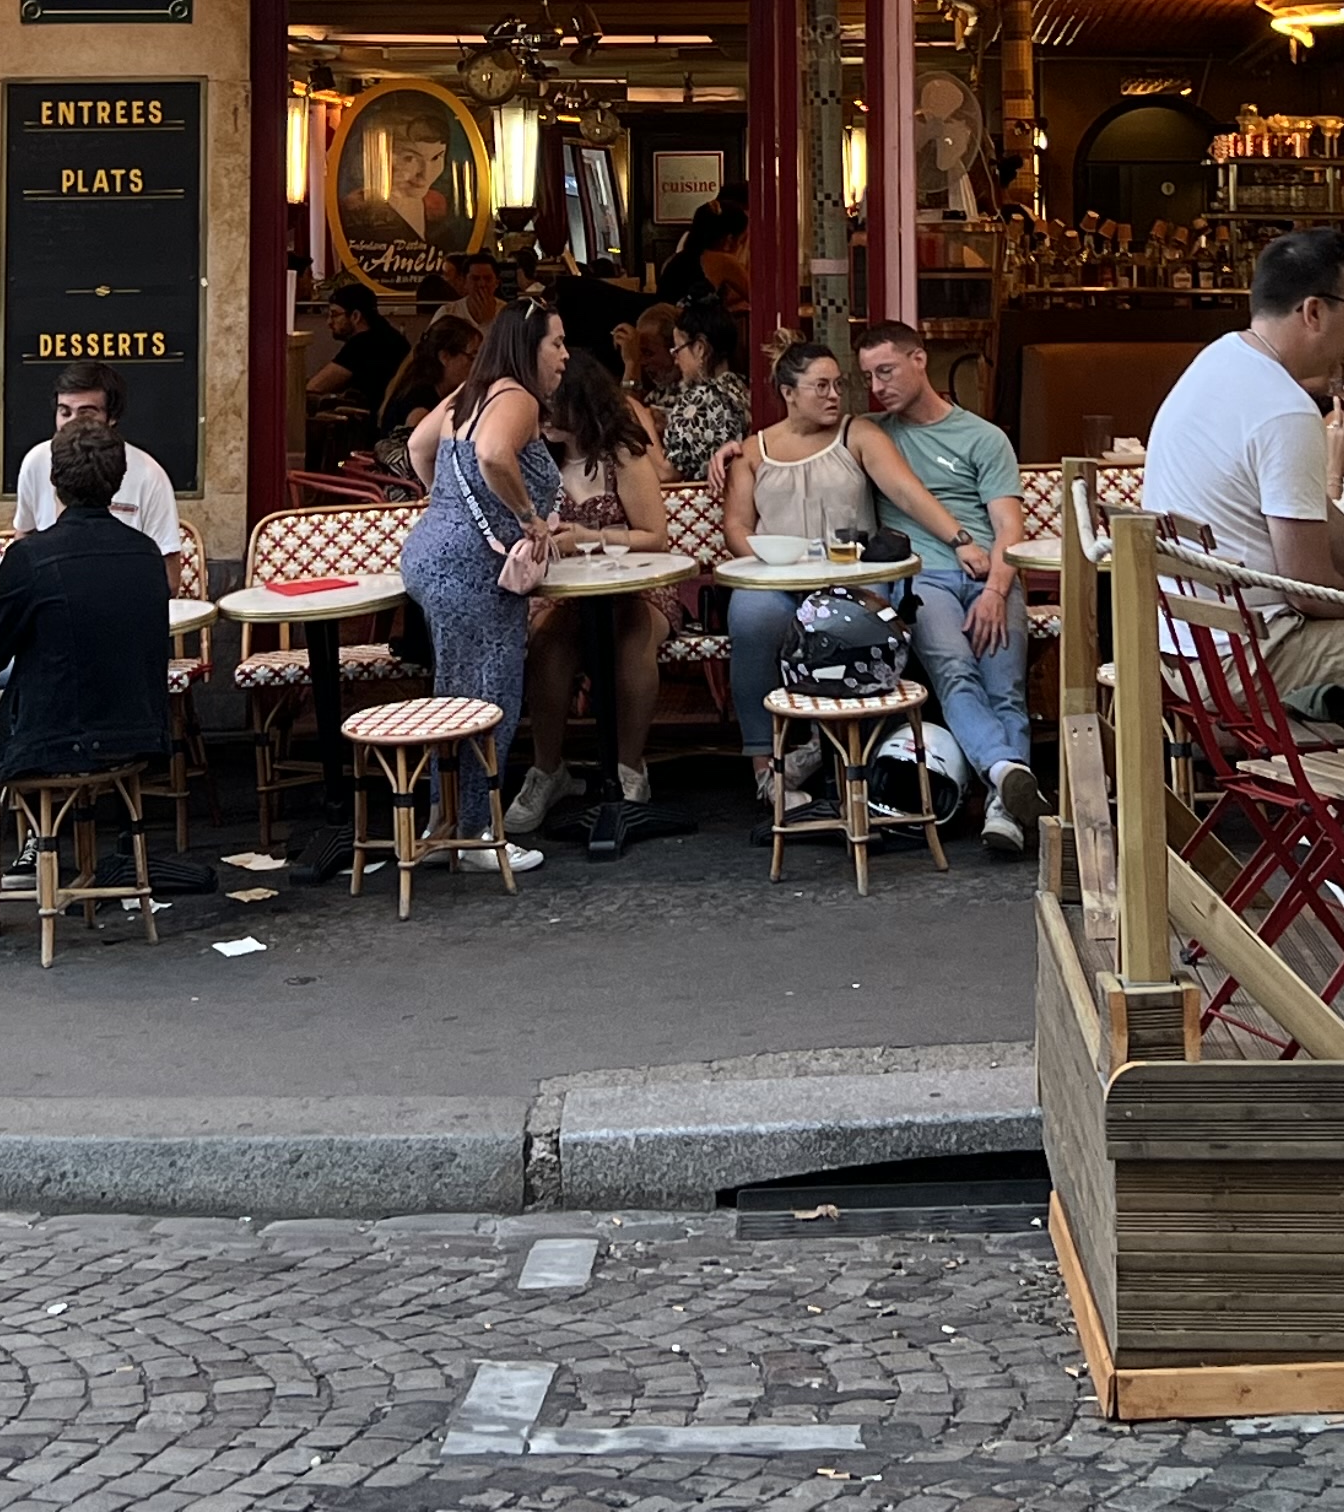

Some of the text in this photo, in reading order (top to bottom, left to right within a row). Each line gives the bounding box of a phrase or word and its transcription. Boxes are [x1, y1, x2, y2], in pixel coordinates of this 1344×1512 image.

[60, 168, 144, 194] PLATS
[661, 175, 717, 194] cuisine
[39, 331, 166, 358] DESSERTS
